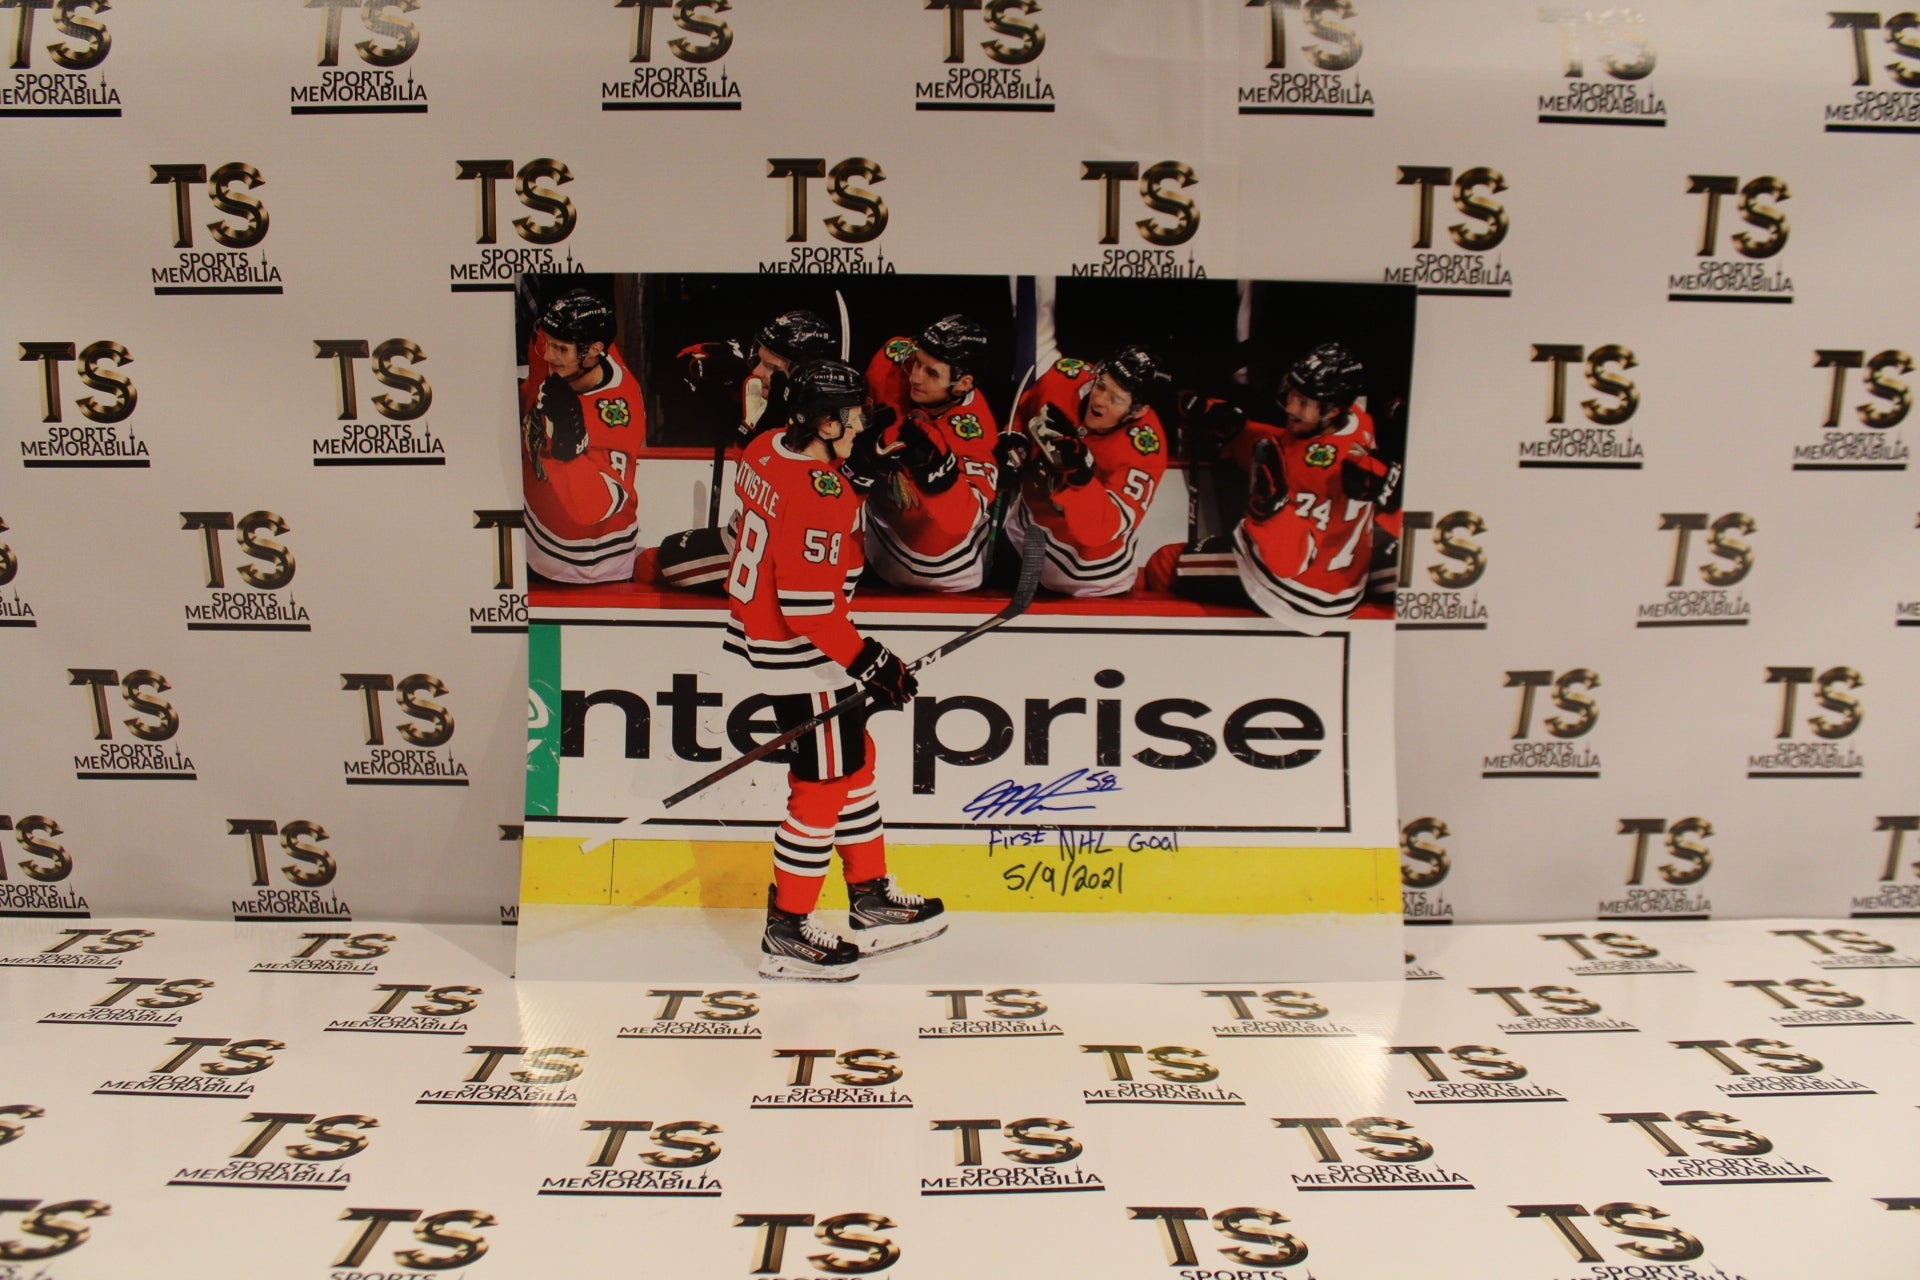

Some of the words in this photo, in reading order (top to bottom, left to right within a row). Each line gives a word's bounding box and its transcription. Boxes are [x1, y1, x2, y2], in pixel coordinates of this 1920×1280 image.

[0, 0, 112, 70] TS
[306, 0, 420, 66] TS
[613, 0, 734, 64] TS
[924, 0, 1046, 66] TS
[1245, 0, 1364, 71] TS
[15, 74, 87, 90] SPORTS
[322, 71, 394, 87] SPORTS
[634, 68, 708, 84] SPORTS
[948, 68, 1022, 84] SPORTS
[1269, 74, 1341, 89] SPORTS
[1568, 83, 1636, 99] SPORTS
[150, 162, 270, 248] TS
[455, 158, 578, 245] TS
[766, 157, 889, 244] TS
[1080, 160, 1200, 246] TS
[1396, 166, 1510, 251] TS
[1686, 175, 1792, 259] TS
[179, 252, 248, 269] SPORTS
[481, 249, 553, 265] SPORTS
[791, 247, 864, 262] SPORTS
[1103, 250, 1175, 266] SPORTS
[1415, 254, 1484, 270] SPORTS
[1699, 262, 1765, 277] SPORTS
[18, 340, 138, 424] TS
[313, 338, 432, 420] TS
[1530, 344, 1640, 425] TS
[1813, 349, 1913, 429] TS
[48, 428, 116, 443] SPORTS
[342, 424, 412, 440] SPORTS
[1549, 429, 1616, 444] SPORTS
[1823, 432, 1885, 447] SPORTS
[1294, 491, 1332, 532] 74
[180, 510, 296, 589] TS
[472, 510, 524, 589] T
[728, 508, 769, 605] 8
[803, 528, 842, 566] 58
[1658, 512, 1758, 588] TS
[211, 593, 278, 607] SPORTS
[1396, 593, 1461, 606] SPORTS
[1396, 604, 1488, 619] MORABILIA
[1667, 591, 1727, 603] SPORTS
[67, 669, 180, 741] TS
[340, 673, 455, 747] TS
[1503, 668, 1601, 739] TS
[1765, 666, 1865, 740] TS
[100, 744, 164, 758] SPORTS
[371, 750, 436, 763] SPORTS
[1513, 743, 1575, 756] SPORTS
[1777, 743, 1838, 756] SPORTS
[226, 819, 337, 887] TS
[1060, 828, 1113, 861] NHL
[1129, 833, 1179, 853] Goal
[1401, 817, 1451, 888] S
[1617, 816, 1714, 886] TS
[1003, 861, 1123, 897] 5/9/2021
[1628, 889, 1687, 902] SPORTS
[257, 890, 320, 902] SPORTS
[40, 929, 155, 955] TS
[291, 932, 398, 960] TS
[1538, 932, 1661, 960] TS
[1769, 928, 1897, 956] TS
[90, 978, 216, 1009] TS
[368, 984, 485, 1017] TS
[645, 989, 761, 1021] TS
[926, 988, 1049, 1021] TS
[1201, 990, 1330, 1021] TS
[1469, 985, 1603, 1018] TS
[1724, 978, 1866, 1009] TS
[148, 1037, 286, 1076] TS
[462, 1045, 588, 1085] TS
[772, 1048, 903, 1087] TS
[1079, 1045, 1220, 1084] TS
[1383, 1044, 1528, 1082] TS
[1667, 1038, 1824, 1077] TS
[146, 1075, 229, 1087] SPORTS
[462, 1084, 543, 1095] SPORTS
[791, 1087, 874, 1098] SPORTS
[1118, 1083, 1201, 1094] SPORTS
[1437, 1082, 1519, 1093] SPORTS
[1741, 1076, 1824, 1086] SPORTS
[228, 1112, 381, 1162] TS
[580, 1119, 725, 1168] TS
[929, 1117, 1083, 1167] TS
[1270, 1117, 1434, 1164] TS
[1597, 1111, 1773, 1157] TS
[226, 1161, 321, 1175] SPORTS
[589, 1170, 683, 1182] SPORTS
[963, 1167, 1057, 1179] SPORTS
[1327, 1165, 1419, 1178] SPORTS
[1677, 1156, 1774, 1171] SPORTS
[330, 1208, 500, 1271] TS
[731, 1213, 901, 1275] TS
[1125, 1206, 1308, 1267] TS
[1507, 1202, 1705, 1263] TS
[1590, 1265, 1697, 1280] SPORTS
